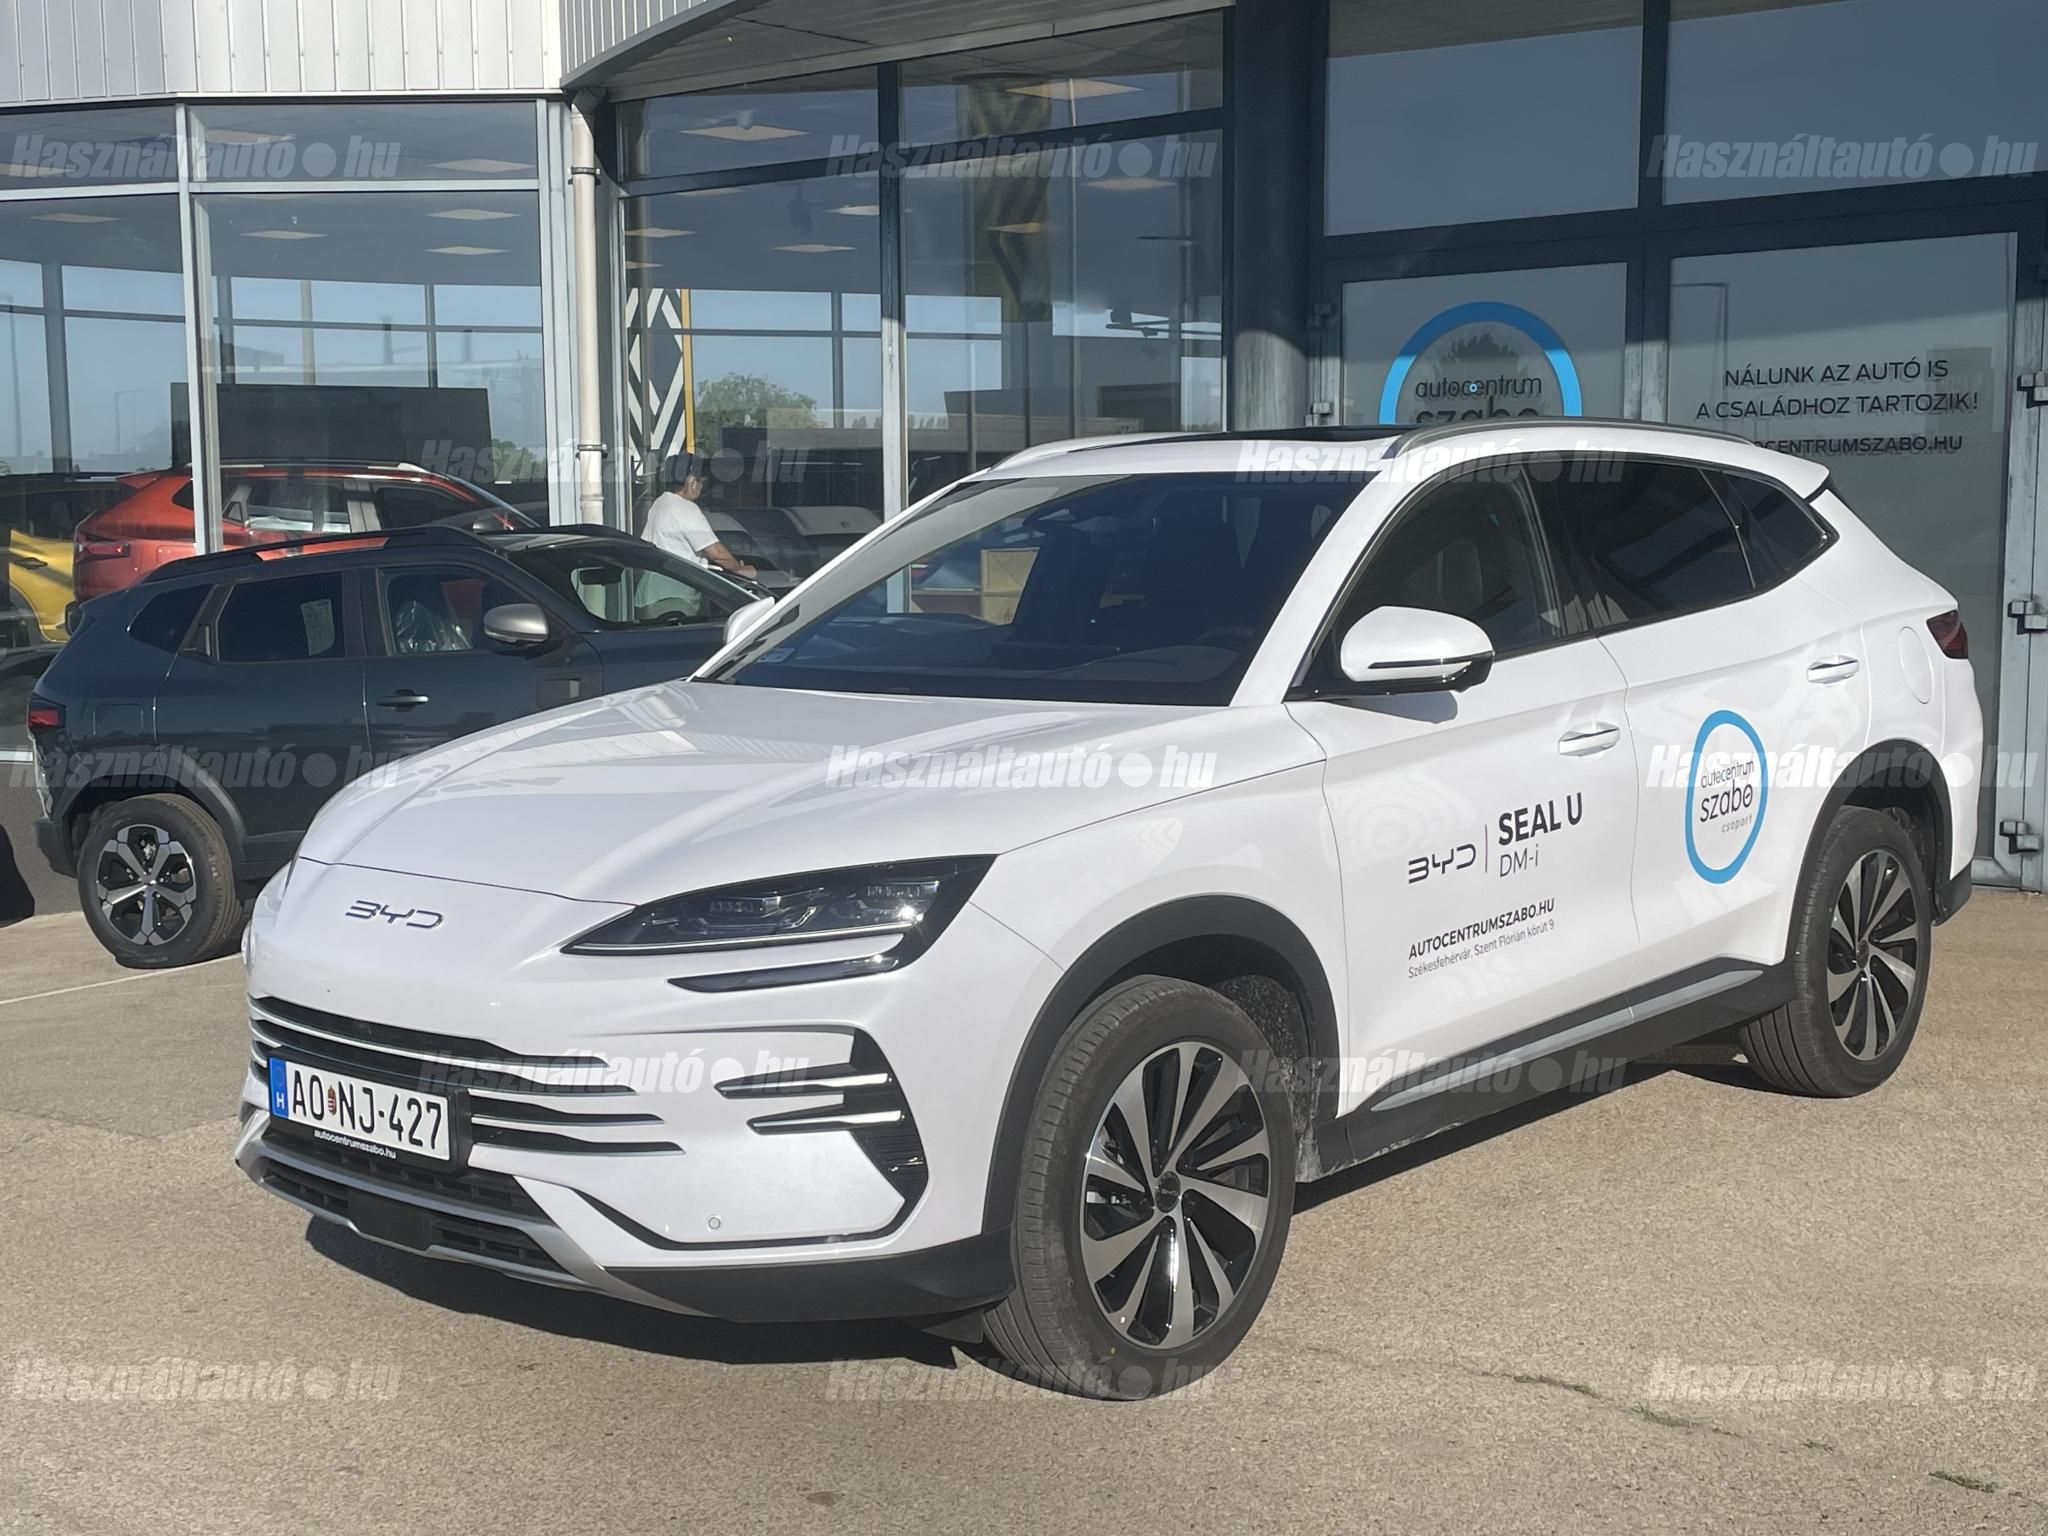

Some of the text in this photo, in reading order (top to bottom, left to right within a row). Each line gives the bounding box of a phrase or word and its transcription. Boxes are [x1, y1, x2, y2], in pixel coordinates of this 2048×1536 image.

[1725, 357, 1949, 387] NÁLUNK AZ AUTÓ IS
[1696, 392, 1978, 420] A CSALÁDHOZ TARTOZIK!
[1498, 792, 1583, 846] SEAL U
[1721, 814, 1753, 833] csoport
[1408, 844, 1476, 884] BYD
[1500, 843, 1539, 878] DM-i
[345, 900, 443, 929] BYD
[1408, 897, 1555, 960] AUTOCENTRUMSZABO.HU
[1408, 948, 1473, 979] Székesfehérvár,
[1474, 940, 1497, 957] Szent
[1499, 930, 1526, 948] Flórián
[1548, 918, 1555, 931] 9
[275, 1069, 442, 1150] H AO NJ-427
[314, 1129, 396, 1159] autocentrumszabo.hu
